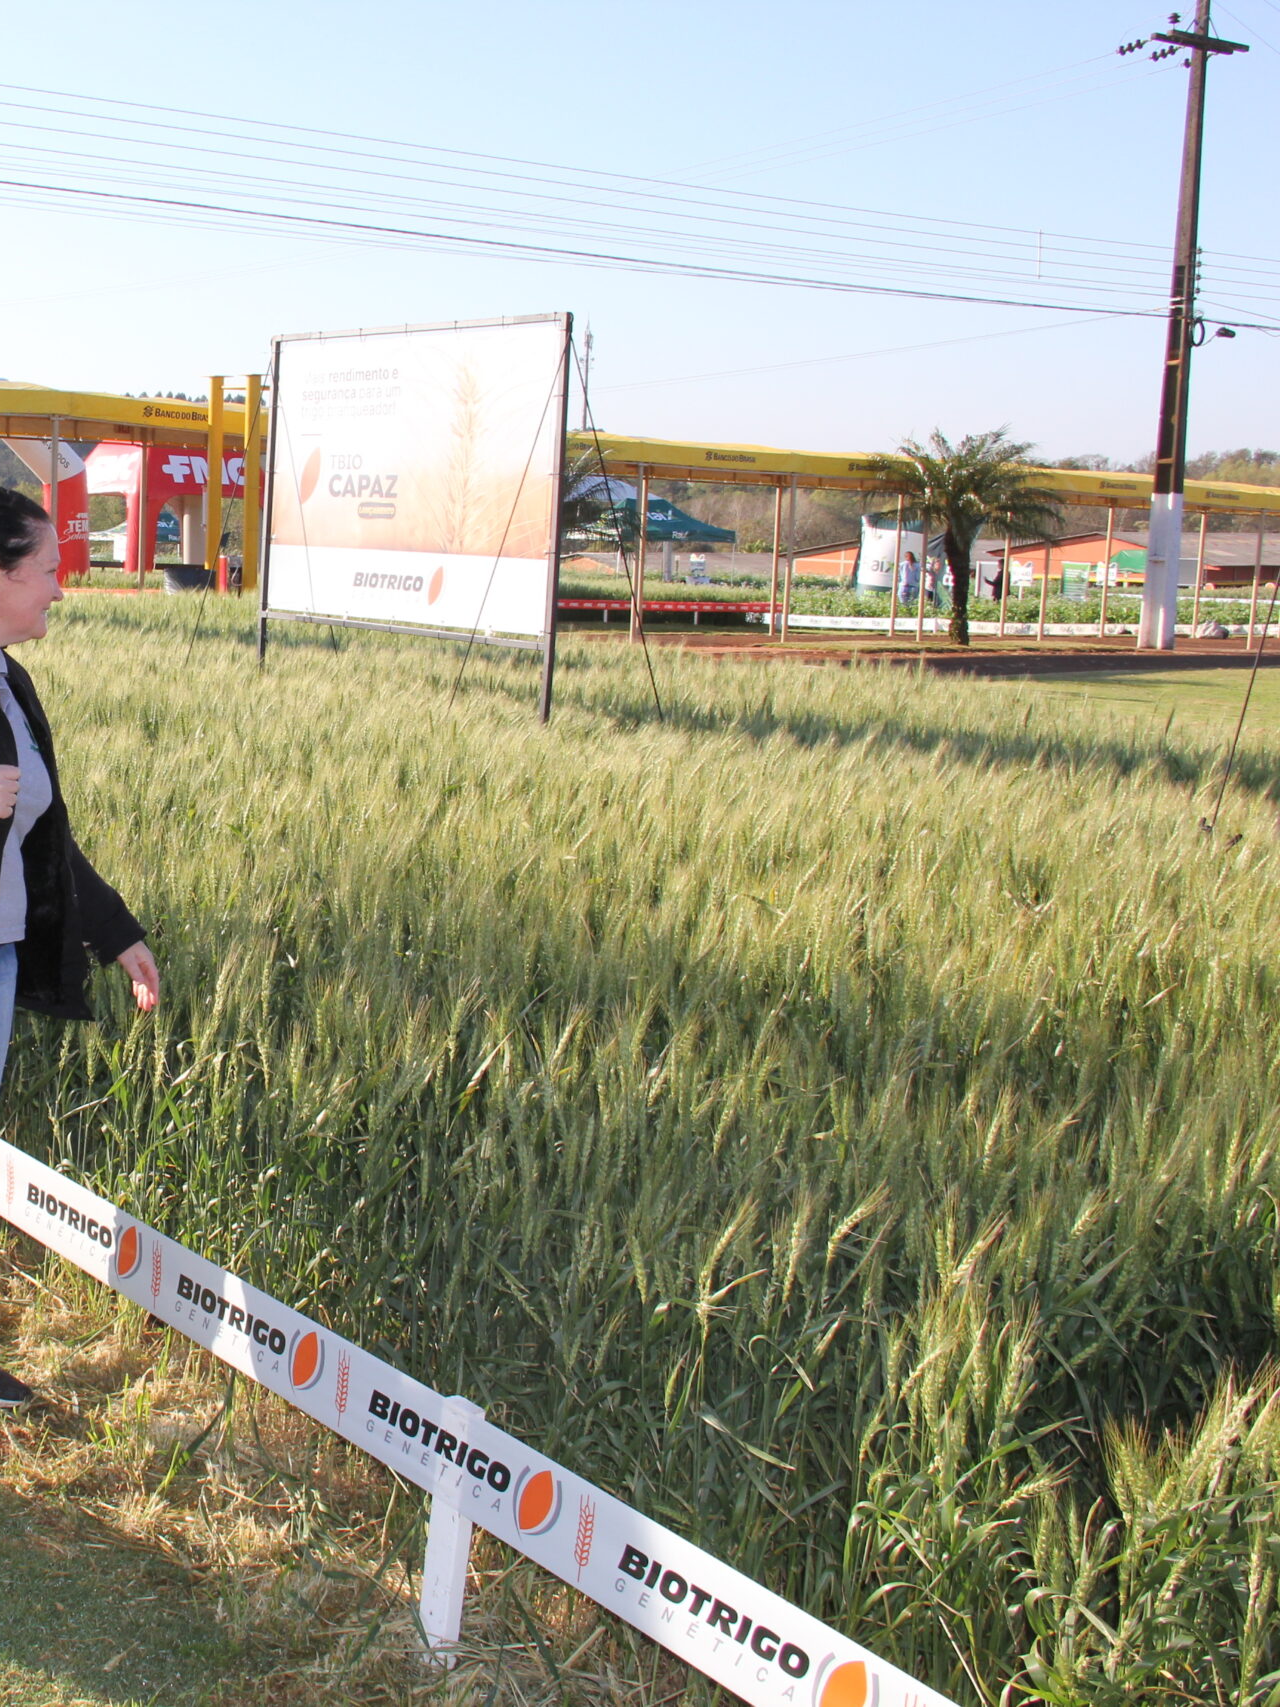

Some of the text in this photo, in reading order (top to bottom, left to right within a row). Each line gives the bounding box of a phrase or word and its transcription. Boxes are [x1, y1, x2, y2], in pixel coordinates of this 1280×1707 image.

[155, 408, 180, 419] BANCO
[181, 412, 191, 420] DO
[162, 455, 246, 486] FMC
[328, 474, 398, 498] CAPAZ
[330, 454, 362, 470] TBIO
[352, 571, 424, 592] BIOTRIGO
[26, 1182, 113, 1250] BIOTRIGO
[176, 1273, 287, 1356] BIOTRIGO
[365, 1419, 502, 1513] GENÉTICA
[368, 1388, 511, 1493] BIOTRIGO
[614, 1577, 795, 1702] GENÉTICA
[617, 1543, 811, 1680] BIOTRIGO
